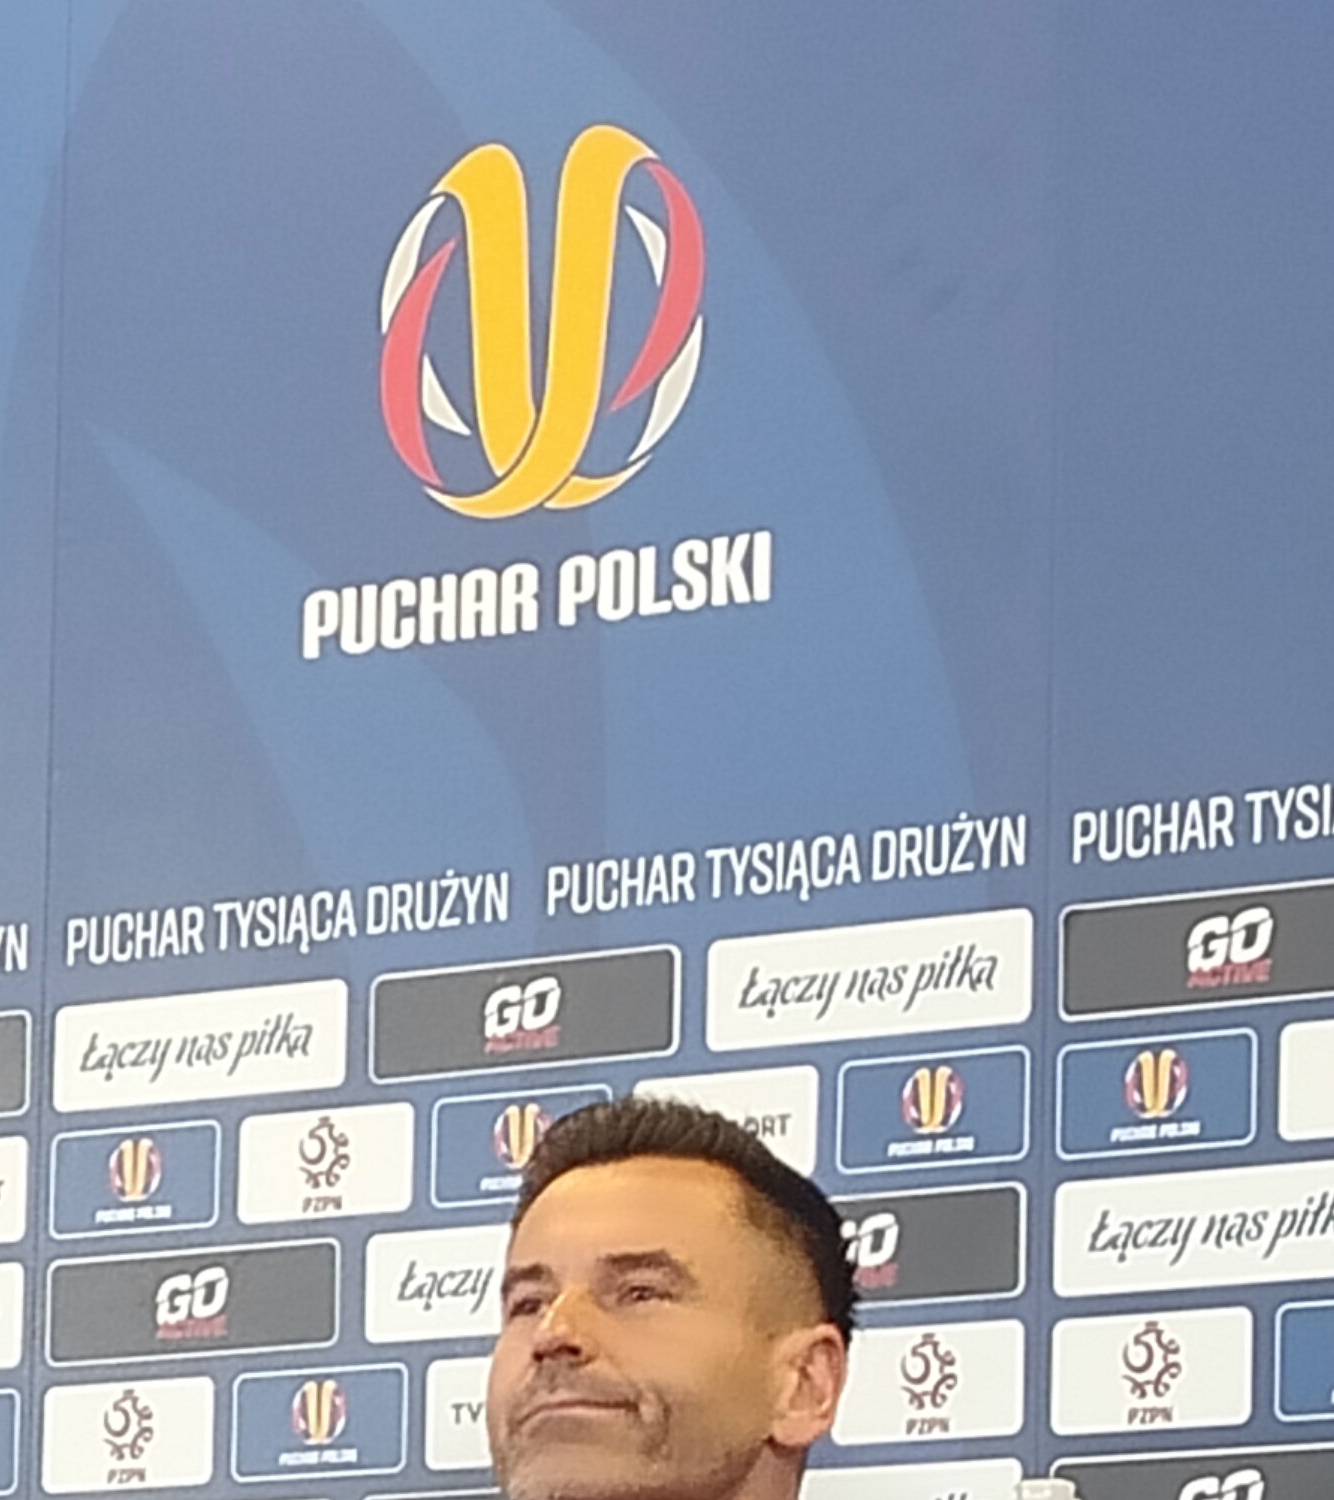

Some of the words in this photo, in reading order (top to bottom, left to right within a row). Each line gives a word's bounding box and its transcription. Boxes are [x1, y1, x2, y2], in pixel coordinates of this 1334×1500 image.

[302, 562, 539, 659] PUCHAR
[558, 531, 772, 626] POLSKI
[1072, 796, 1233, 863] PUCHAR
[547, 852, 695, 916] PUCHAR
[705, 834, 861, 901] TYSIĄCA
[871, 812, 1027, 881] DRUŻYN
[67, 905, 204, 966] PUCHAR
[213, 889, 356, 953] TYSIĄCA
[366, 869, 509, 935] DRUŻYN
[1186, 907, 1274, 973] GO
[484, 976, 562, 1041] GO
[738, 966, 837, 1021] Łączy
[846, 964, 908, 1002] nas
[903, 944, 998, 1012] piłka
[79, 1032, 168, 1084] Łączy
[176, 1032, 230, 1067] nas
[227, 1013, 314, 1076] piłka
[1088, 1210, 1197, 1266] Łączy
[1201, 1207, 1268, 1249] nas
[155, 1266, 230, 1327] GO
[397, 1261, 495, 1315] Łączy
[451, 1403, 484, 1425] TV
[905, 1417, 950, 1436] PZPN
[1127, 1407, 1173, 1424] PZPN
